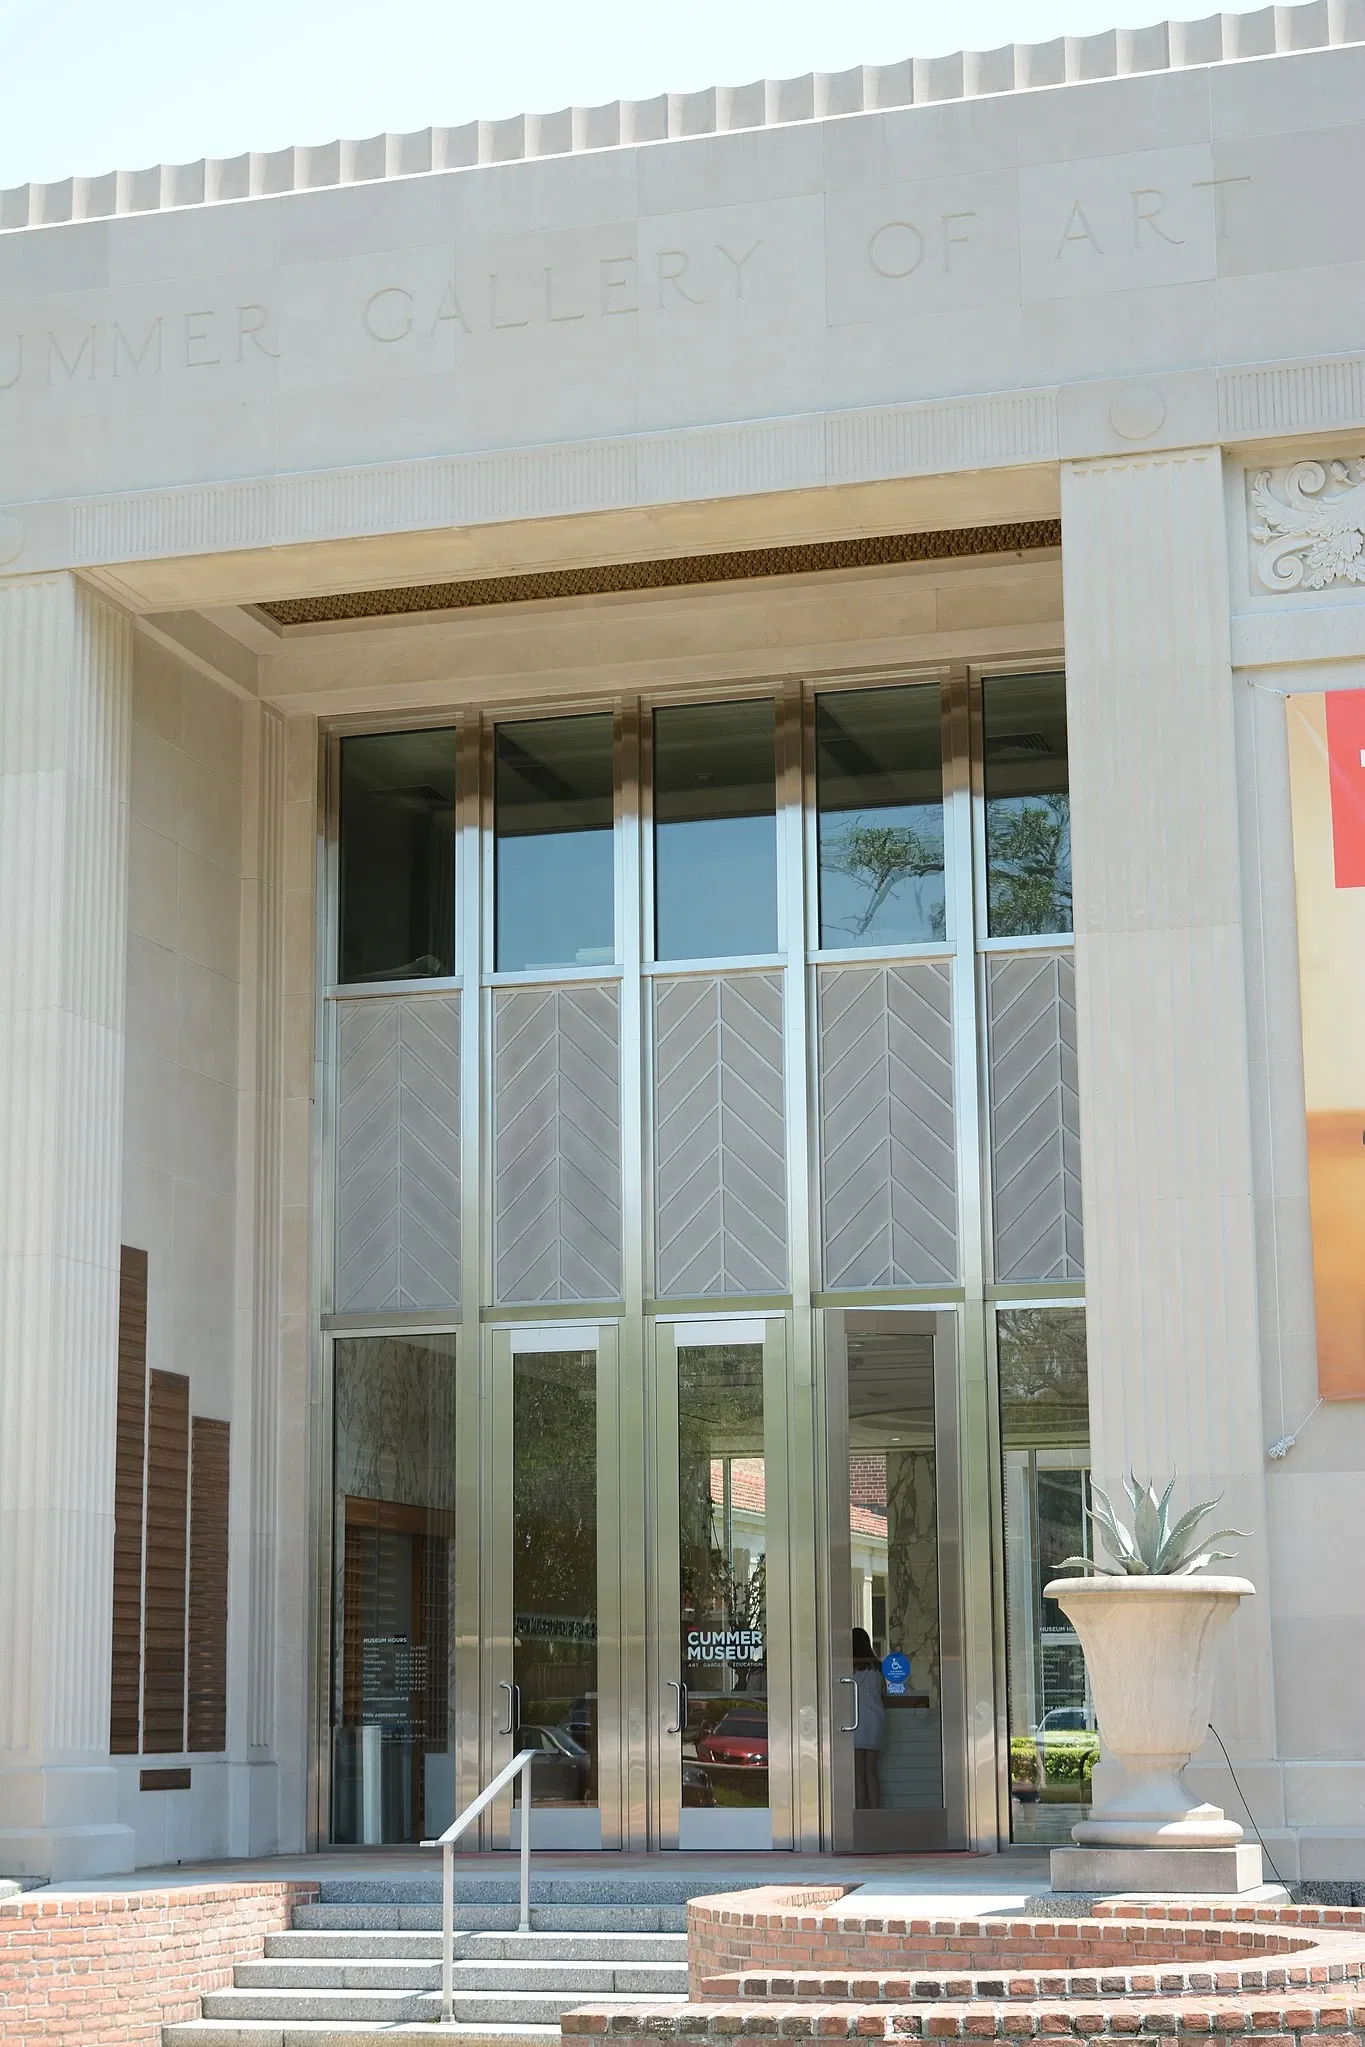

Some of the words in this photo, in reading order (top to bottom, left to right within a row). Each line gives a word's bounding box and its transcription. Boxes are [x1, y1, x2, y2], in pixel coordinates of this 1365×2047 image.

[362, 239, 763, 343] GALLERY
[868, 212, 977, 279] OF
[1053, 175, 1252, 260] ART
[688, 1631, 762, 1645] CUMMER
[688, 1646, 763, 1660] MUSEUM
